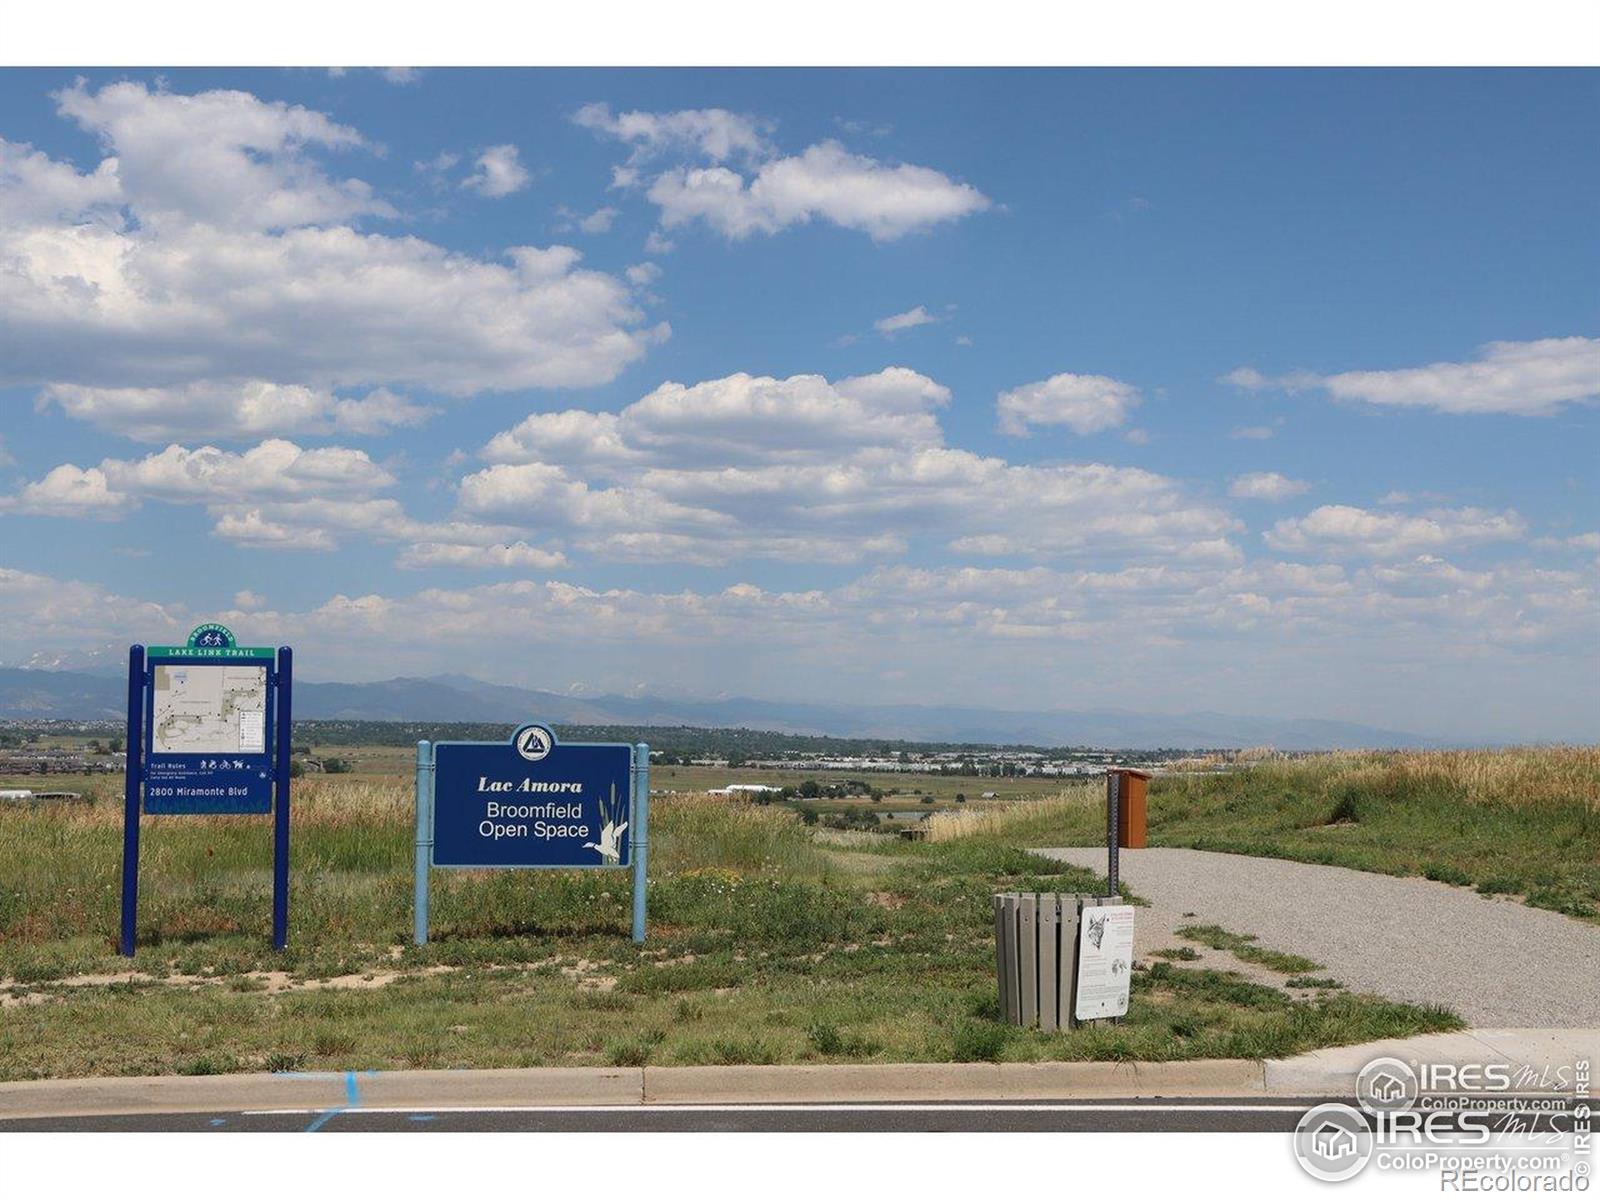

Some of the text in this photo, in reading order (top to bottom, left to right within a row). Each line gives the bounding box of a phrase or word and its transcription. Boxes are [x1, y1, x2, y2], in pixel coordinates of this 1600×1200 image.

[150, 786, 248, 796] 2800 Miramonte Blvd
[477, 776, 583, 793] Lac Amora
[487, 801, 583, 819] Broomfield
[479, 820, 590, 841] Open Space
